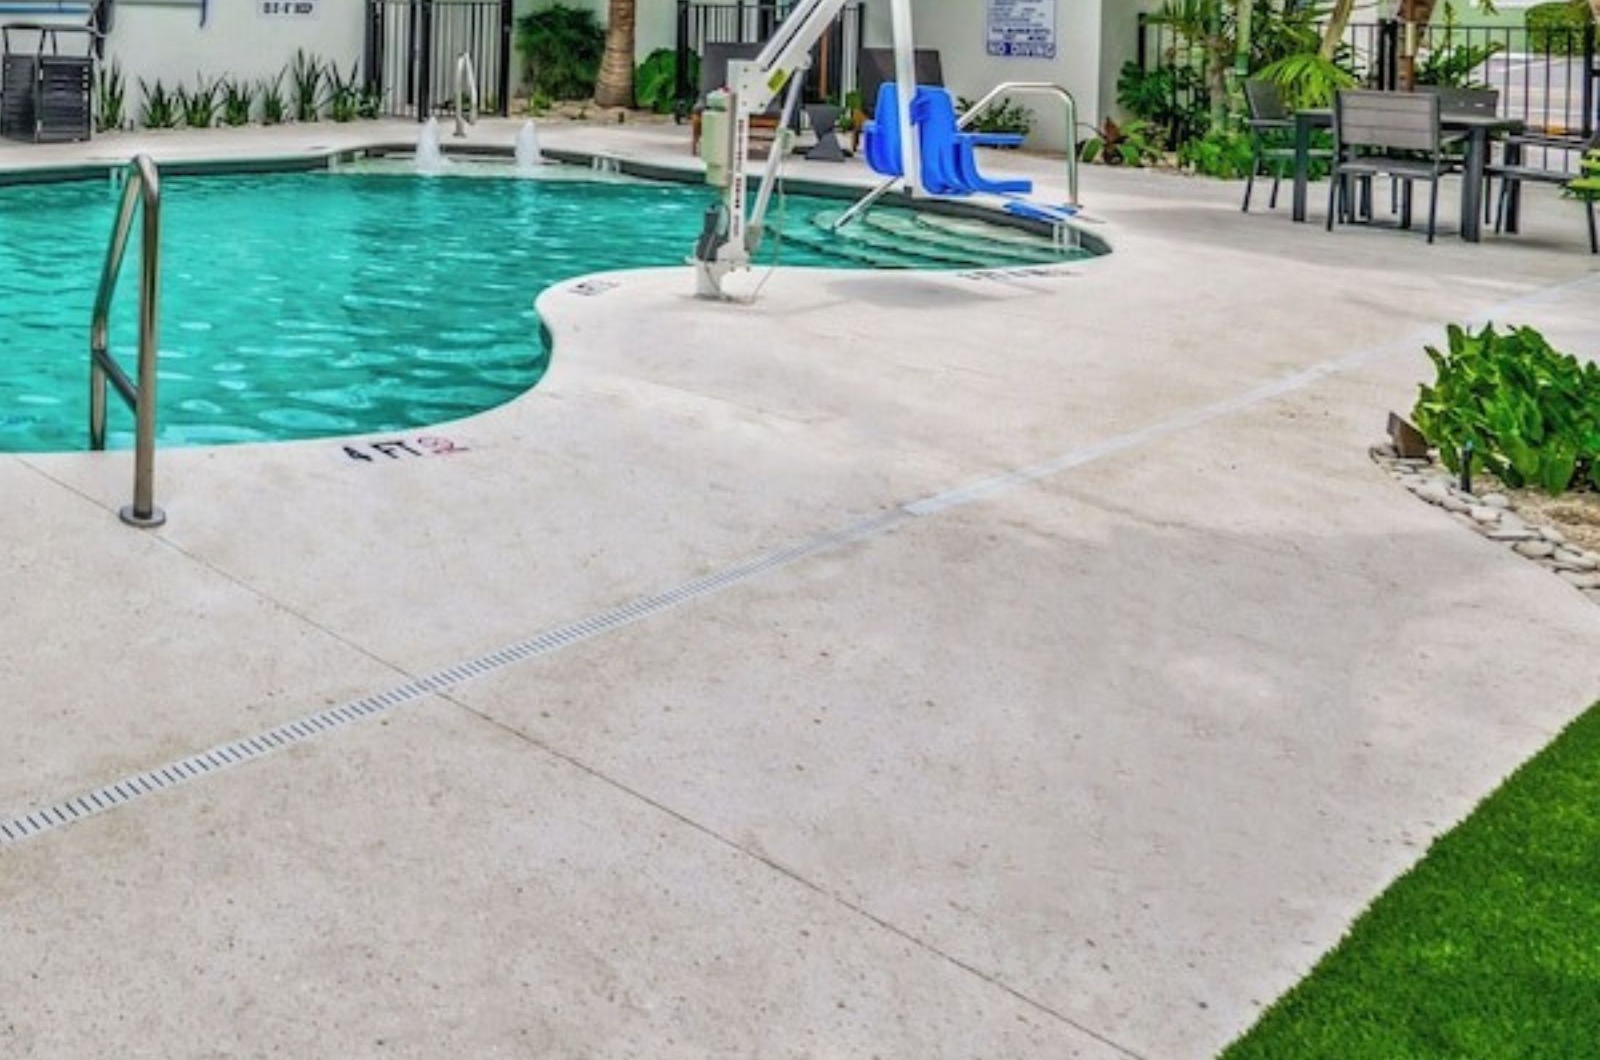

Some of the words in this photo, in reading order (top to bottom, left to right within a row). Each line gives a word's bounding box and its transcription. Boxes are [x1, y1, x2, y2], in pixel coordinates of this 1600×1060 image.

[987, 42, 1006, 55] NO
[1011, 42, 1055, 58] DIVING
[370, 440, 422, 459] FT
